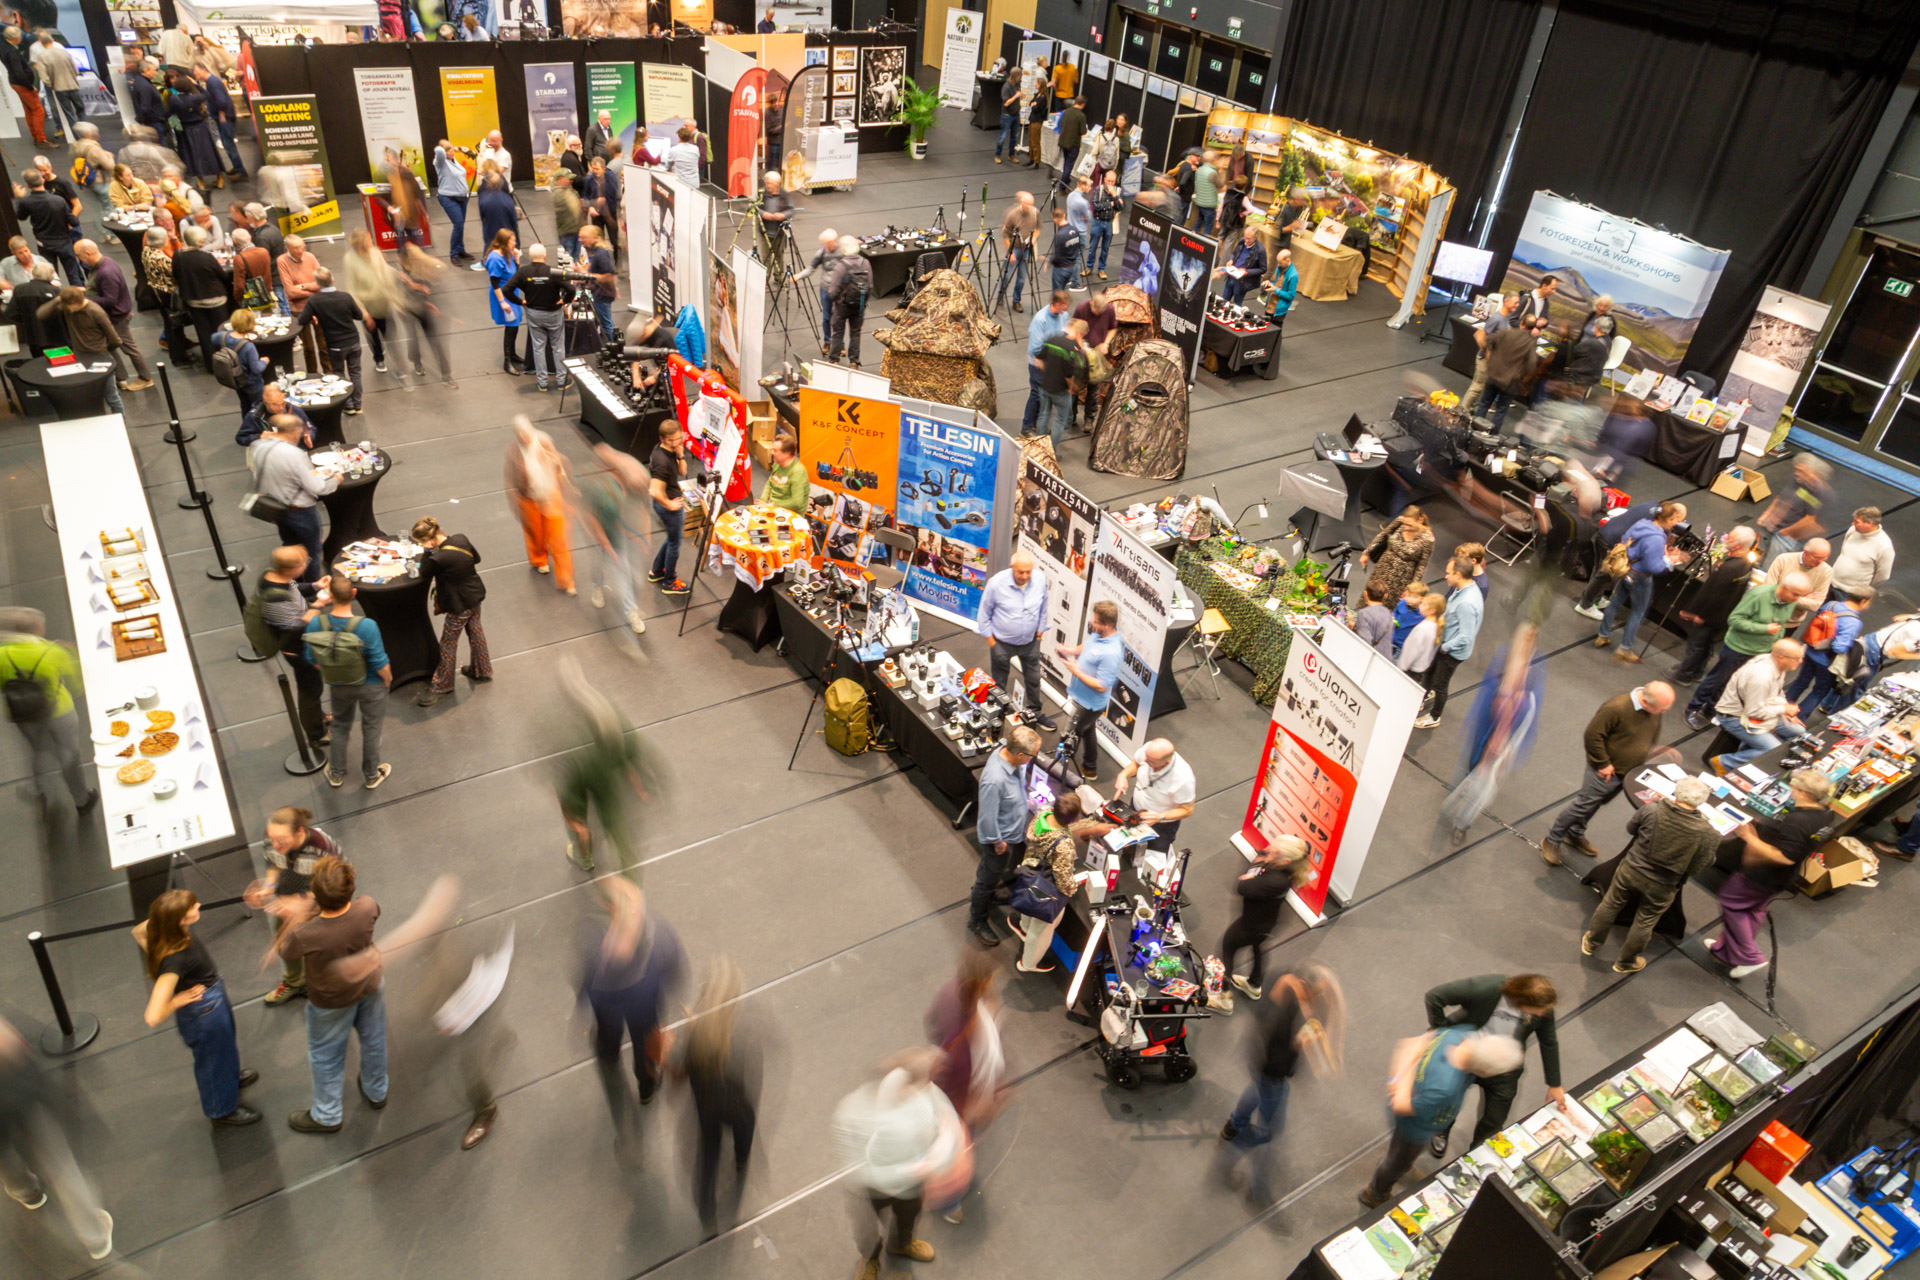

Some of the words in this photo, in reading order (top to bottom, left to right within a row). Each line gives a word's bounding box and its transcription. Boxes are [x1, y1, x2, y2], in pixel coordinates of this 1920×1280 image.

[947, 34, 964, 42] NATURE
[964, 36, 978, 44] FIRST
[535, 88, 568, 96] STARLING
[259, 102, 311, 113] LOWLAND
[264, 112, 311, 123] KORTING
[267, 139, 319, 147] FOTO-INSPIRATIE
[1139, 216, 1161, 233] Canon
[1181, 236, 1204, 253] Canon
[1540, 226, 1602, 255] FOTOREIZEN
[1602, 248, 1611, 257] &
[1613, 252, 1681, 283] WORKSHOPS
[812, 419, 832, 429] K&F
[835, 424, 885, 439] CONCEPT
[905, 416, 994, 456] TELESIN
[920, 441, 940, 453] Premium
[944, 448, 976, 462] Accessories
[923, 448, 932, 456] for
[932, 450, 950, 461] Action
[950, 456, 974, 468] Cameras
[1033, 467, 1089, 515] TTARTISAN
[1112, 531, 1161, 582] 7Artisans
[911, 569, 967, 595] www.telesin.nl
[917, 581, 958, 605] Movidis
[1299, 671, 1318, 692] create
[1320, 688, 1329, 700] for
[1329, 700, 1356, 728] creators
[1318, 666, 1361, 716] Ulanzi
[1096, 719, 1120, 744] ovidis
